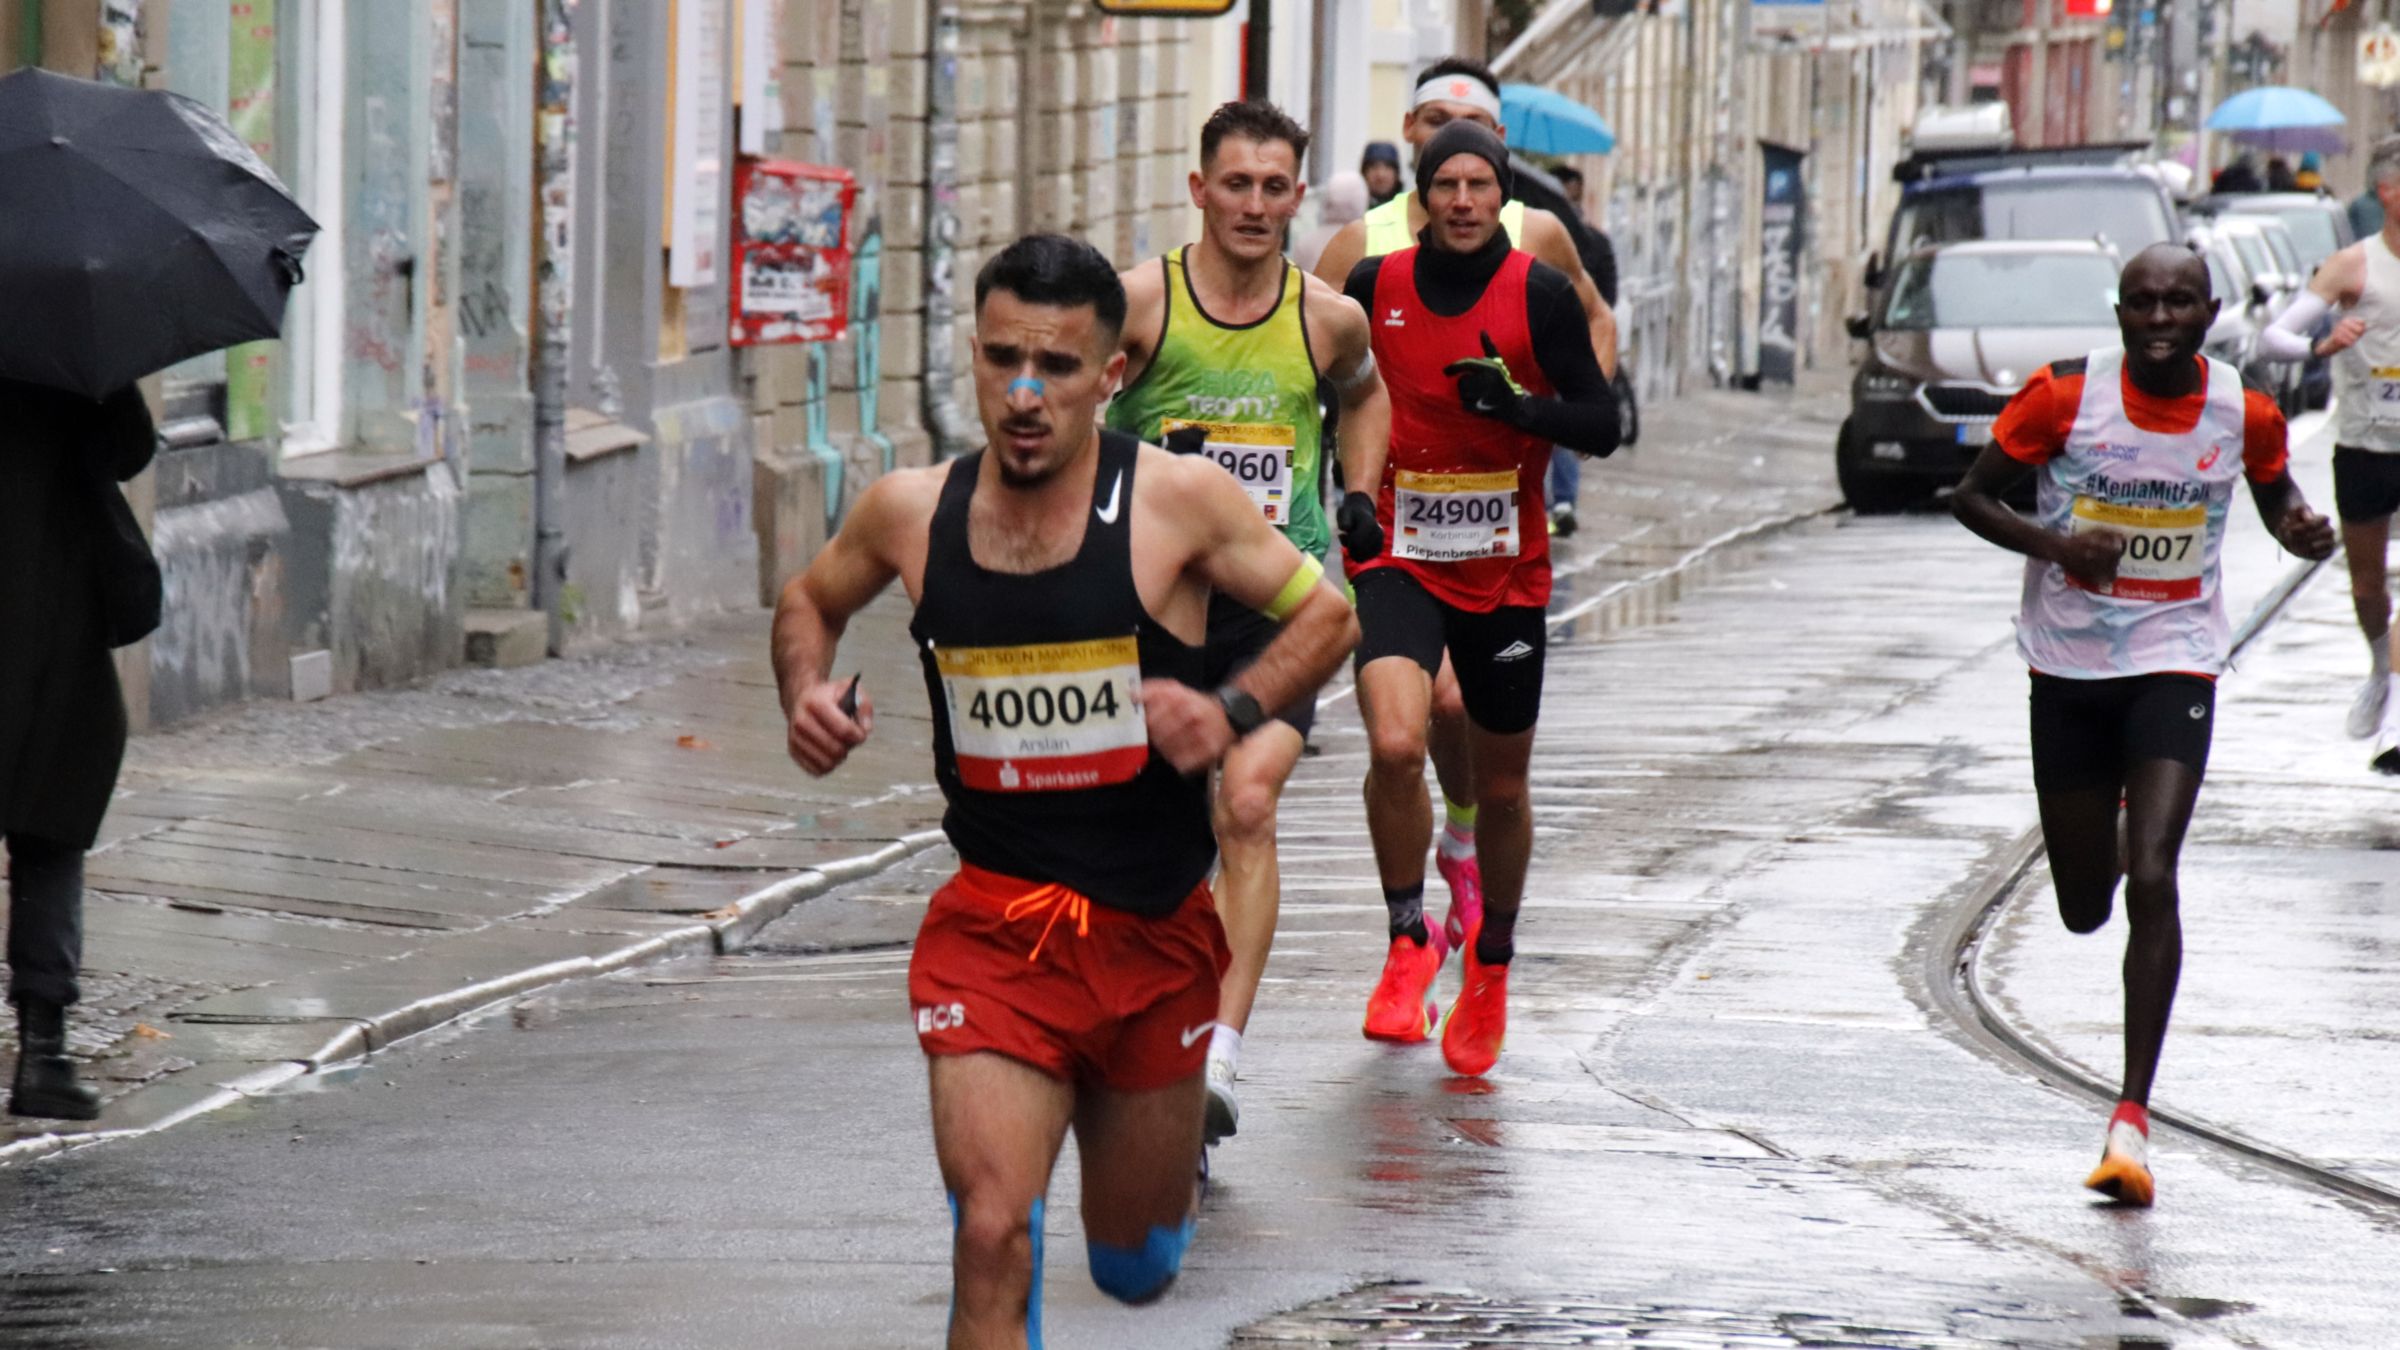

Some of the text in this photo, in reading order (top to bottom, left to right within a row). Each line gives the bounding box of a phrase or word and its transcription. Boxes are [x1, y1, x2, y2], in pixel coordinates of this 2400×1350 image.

[1409, 497, 1504, 525] 24900
[2119, 565, 2160, 577] ickson
[968, 679, 1120, 729] 40004
[1018, 736, 1071, 751] Arslan
[1025, 770, 1099, 788] Sparkasse
[914, 1002, 965, 1034] EOS
